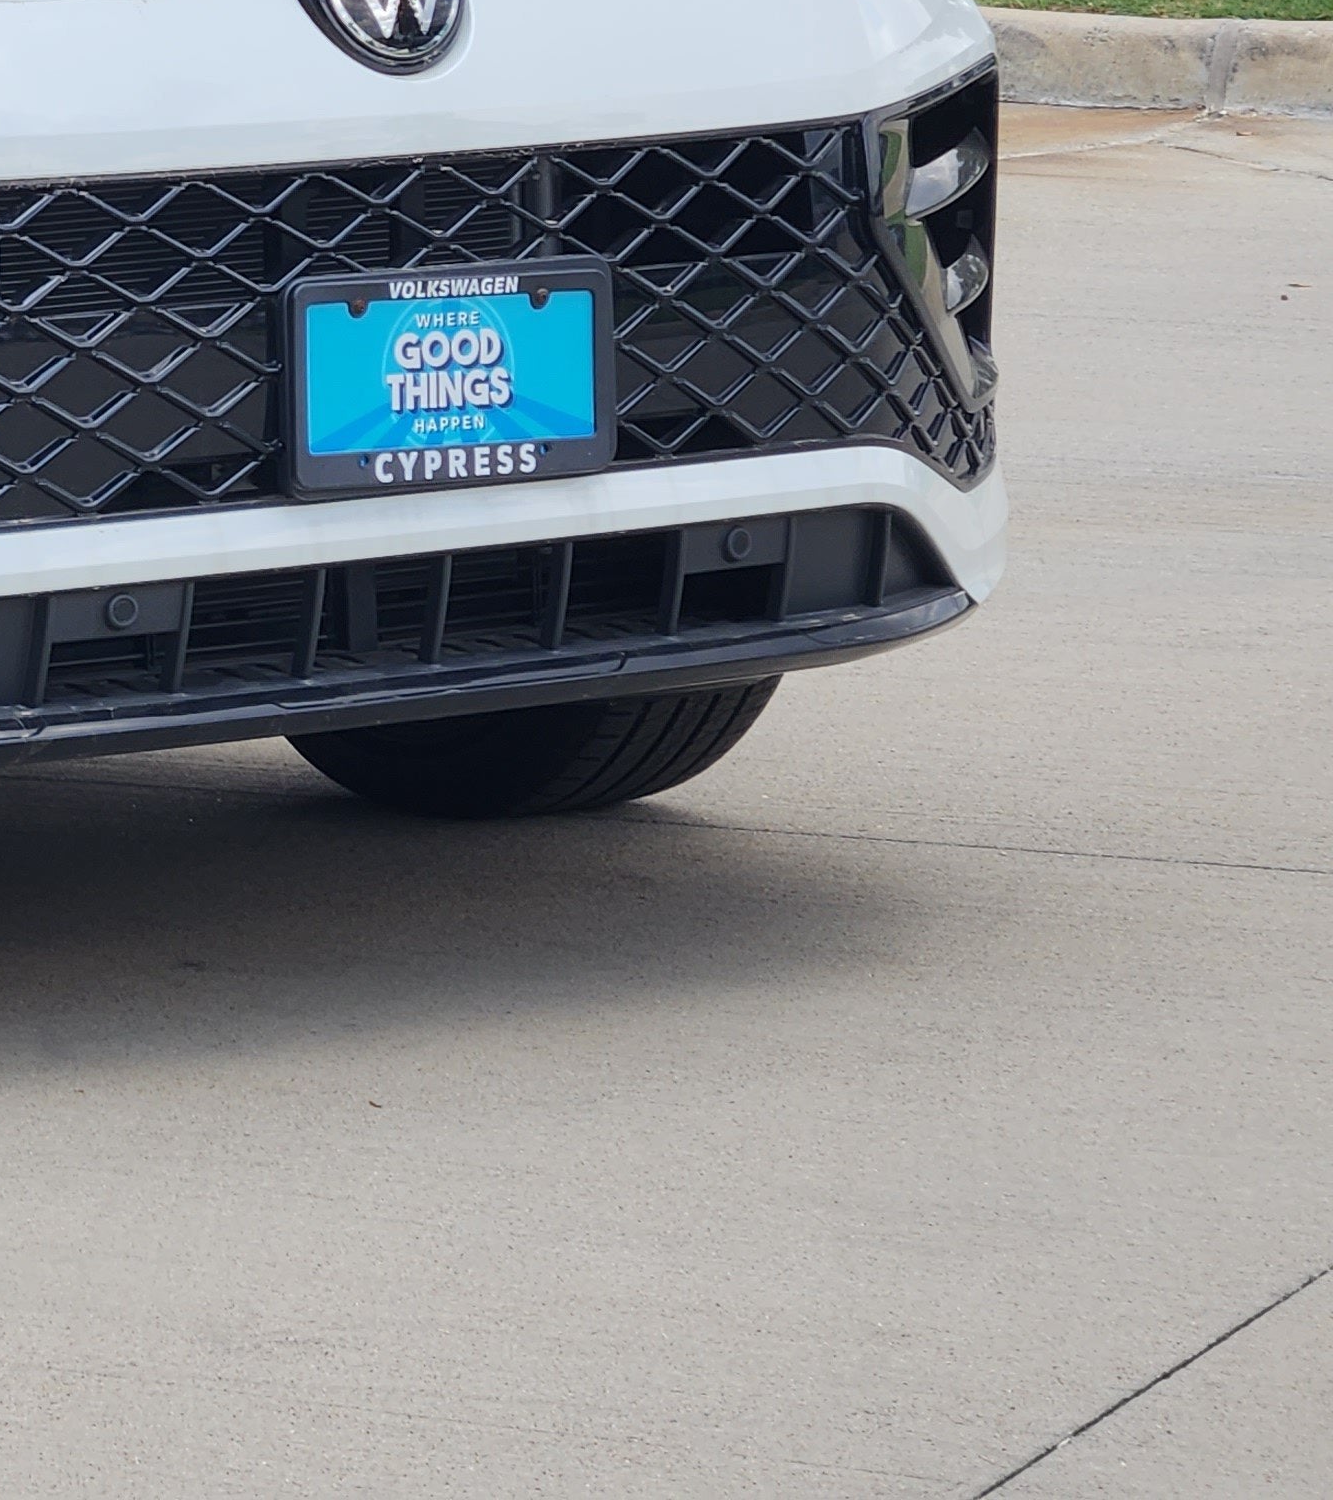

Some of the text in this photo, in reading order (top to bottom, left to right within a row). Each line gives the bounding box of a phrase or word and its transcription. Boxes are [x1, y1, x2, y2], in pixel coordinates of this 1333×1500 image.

[389, 276, 520, 300] VOLKSWAGEN
[415, 310, 481, 329] WHERE
[394, 328, 503, 370] GOOD
[386, 369, 513, 412] THINGS
[413, 415, 487, 435] HAPPEN
[375, 444, 538, 485] CYPRESS
